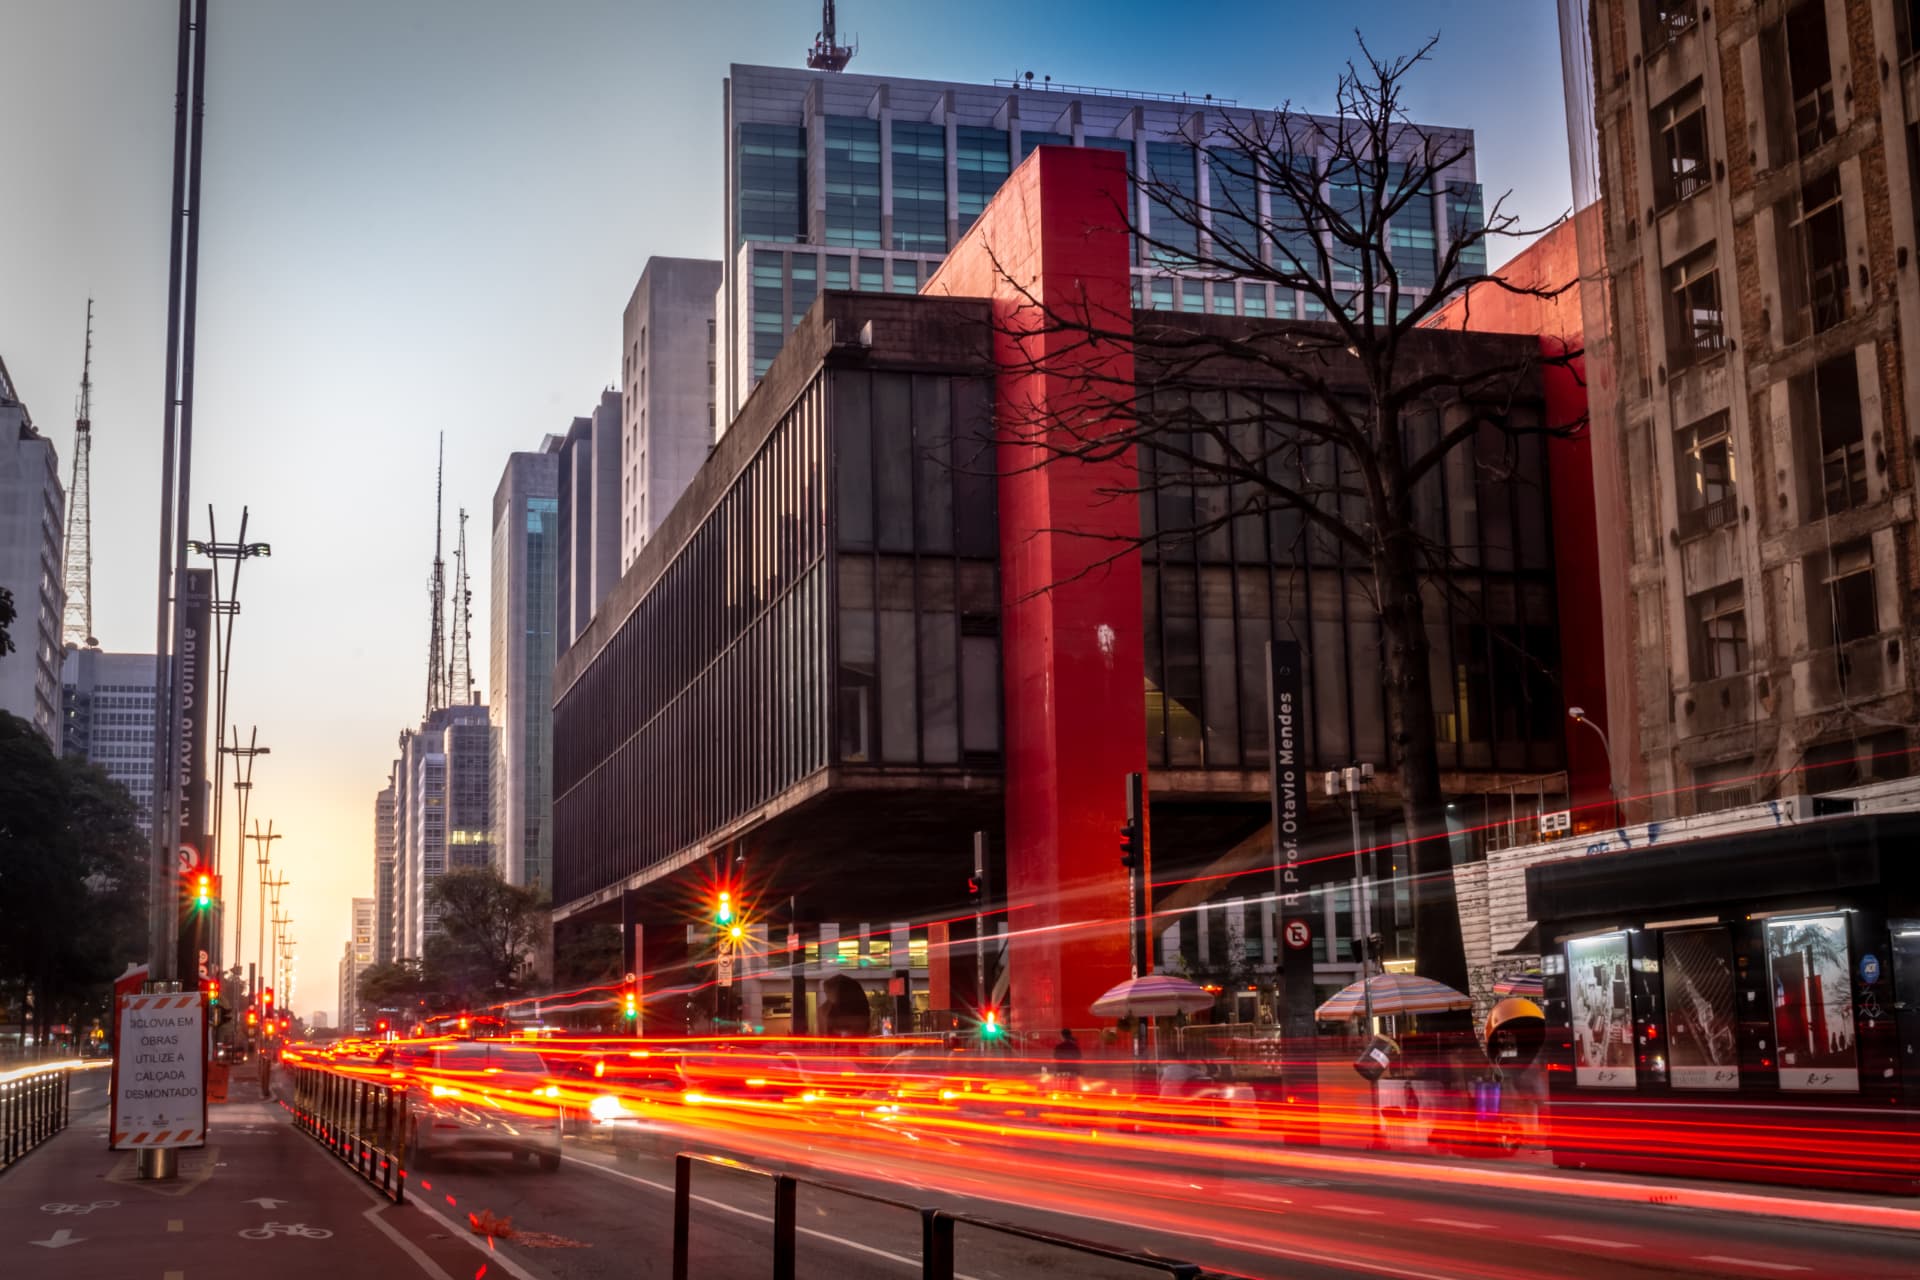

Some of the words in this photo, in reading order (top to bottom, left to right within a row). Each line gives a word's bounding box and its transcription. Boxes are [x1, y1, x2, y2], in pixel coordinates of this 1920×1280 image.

[1278, 692, 1293, 765] Mendes
[1282, 771, 1296, 833] Otavio
[1284, 839, 1298, 882] Prof.
[1285, 888, 1298, 907] R.
[177, 1016, 194, 1027] EM
[140, 1035, 178, 1046] OBRAS
[135, 1053, 175, 1064] UTILIZE
[177, 1053, 185, 1062] A
[135, 1070, 185, 1082] CALÇADA
[124, 1087, 198, 1099] DESMONTADO
